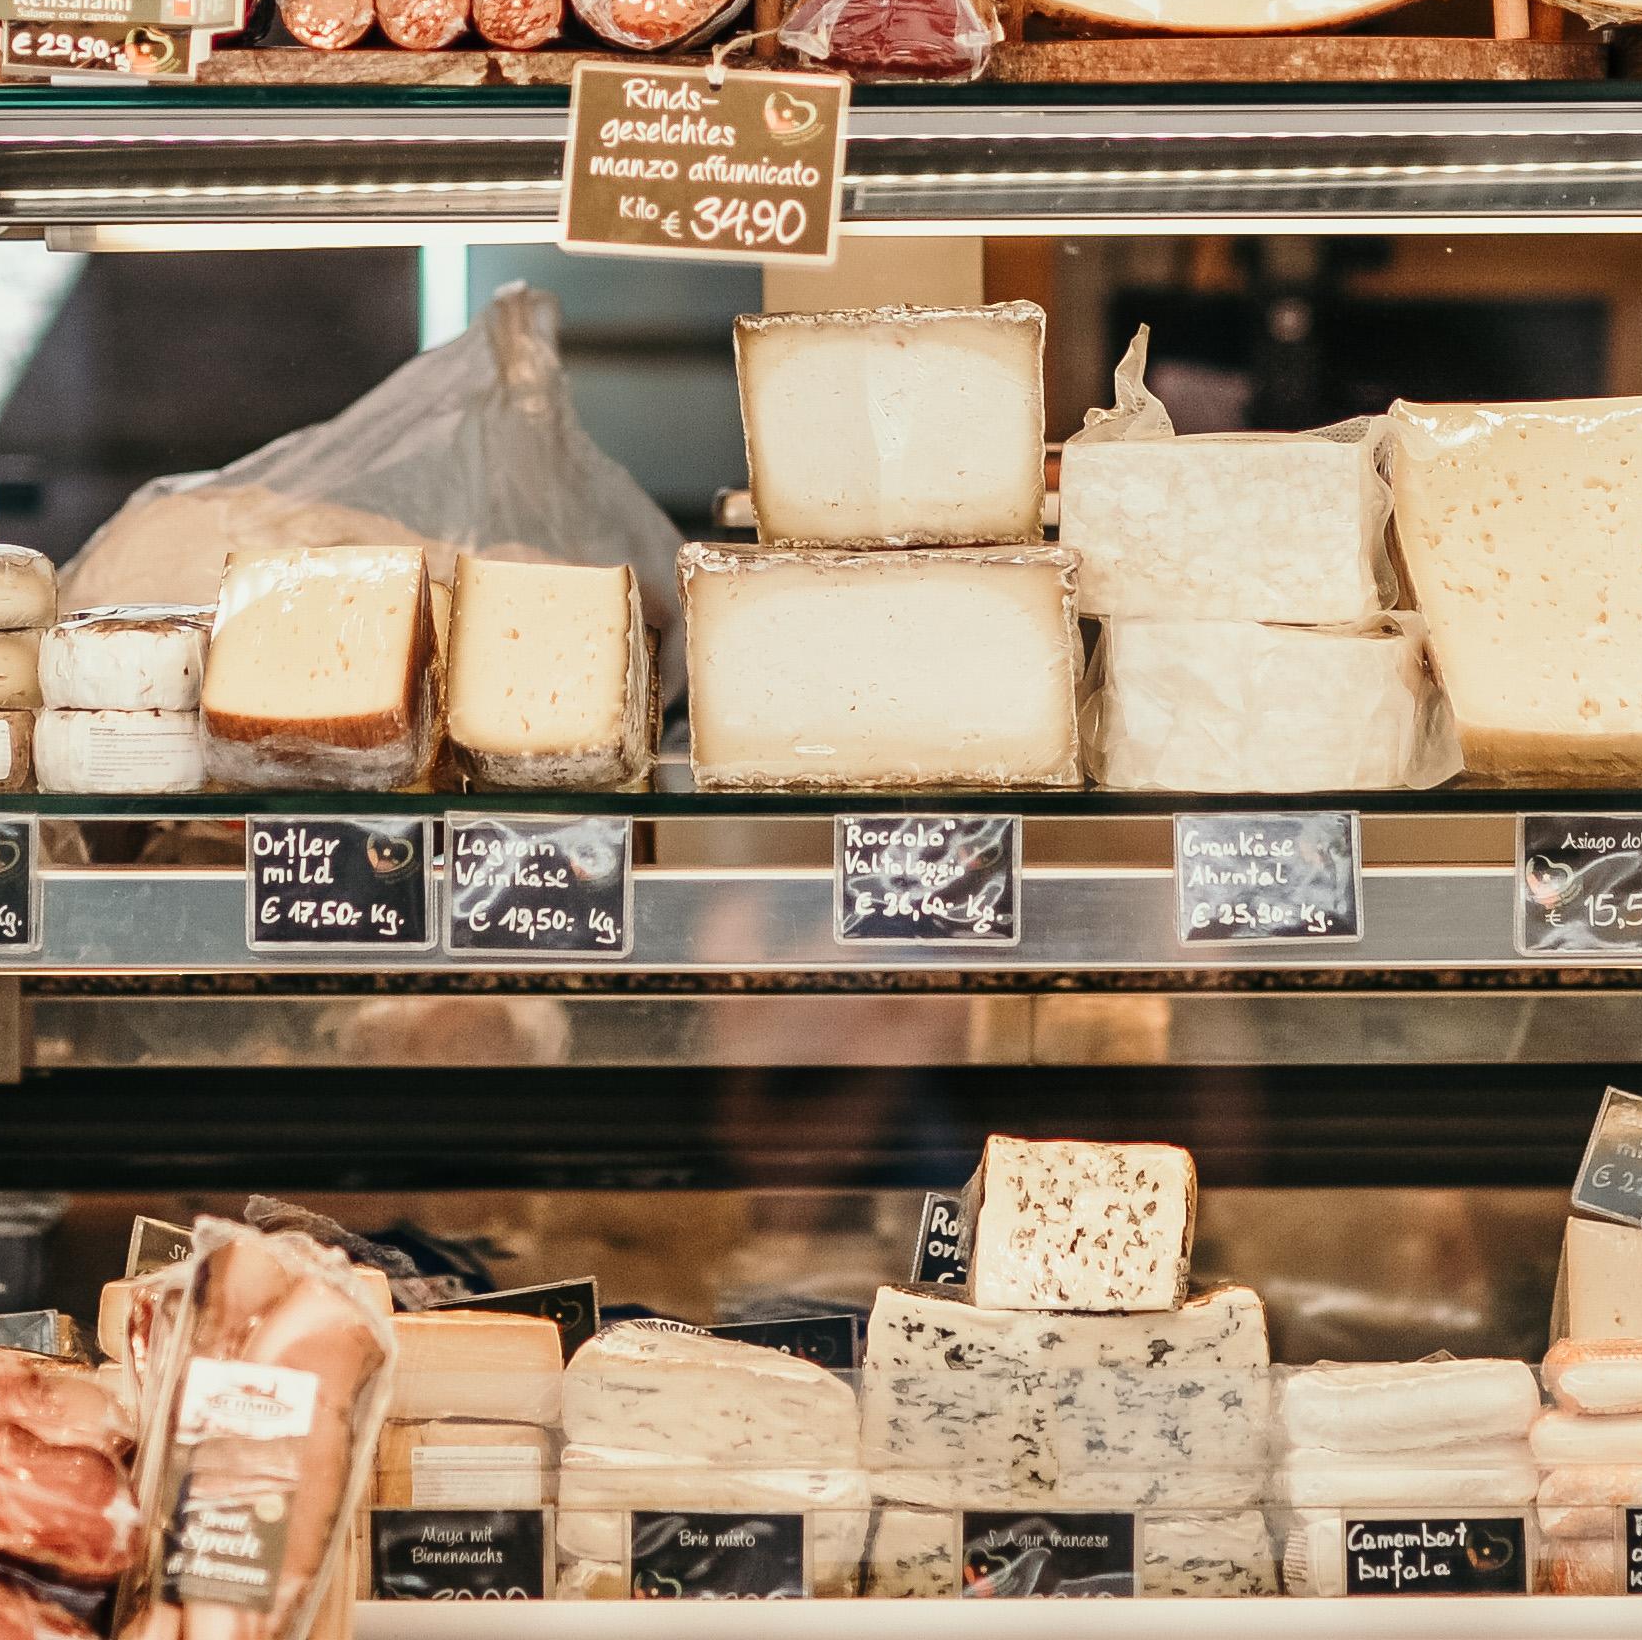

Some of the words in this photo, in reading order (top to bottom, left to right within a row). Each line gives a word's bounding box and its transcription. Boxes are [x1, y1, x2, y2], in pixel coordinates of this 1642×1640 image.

[622, 78, 720, 112] Rinds-
[600, 115, 735, 148] geselchtes
[590, 155, 678, 180] manzo
[688, 156, 820, 188] affumicato
[619, 195, 659, 220] Kilo
[661, 211, 685, 238] €
[690, 197, 807, 246] 34,90
[253, 829, 340, 857] Ortler
[1560, 833, 1615, 853] Asiago
[262, 859, 334, 885] mild
[1188, 864, 1288, 886] Ahrntal
[371, 904, 405, 935] Kg.
[421, 1526, 465, 1546] Maya
[471, 1526, 493, 1543] mit
[679, 1529, 708, 1546] Brie
[715, 1530, 755, 1546] misto
[1348, 1523, 1466, 1550] Camembert
[411, 1546, 503, 1565] Bienenwachs
[1358, 1551, 1450, 1588] bufala
